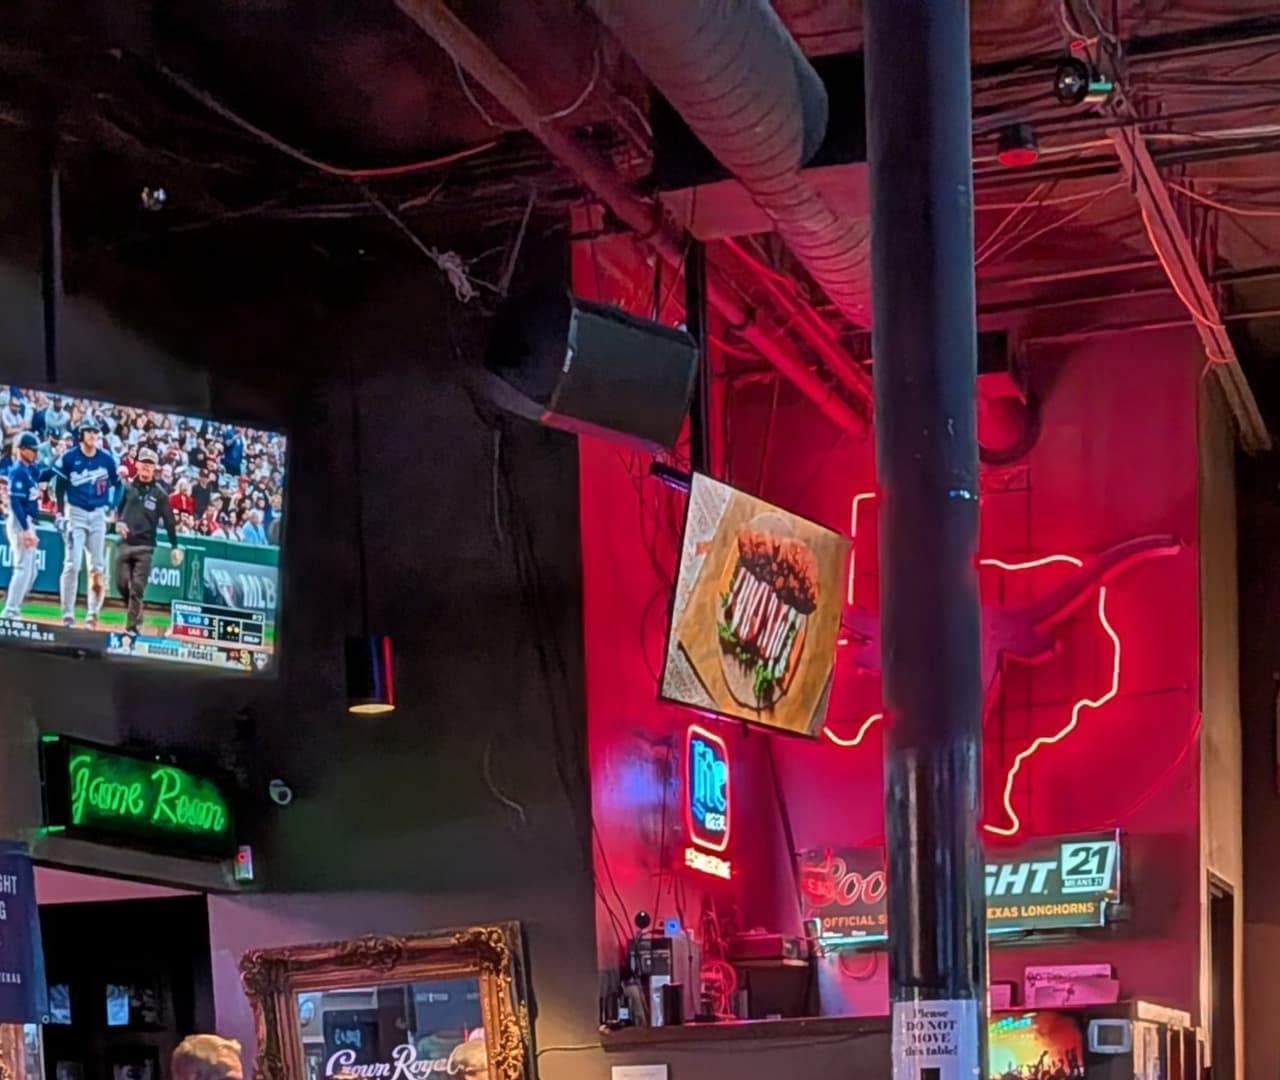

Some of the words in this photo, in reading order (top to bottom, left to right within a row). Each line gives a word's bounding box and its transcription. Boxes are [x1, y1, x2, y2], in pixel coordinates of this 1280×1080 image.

[70, 755, 144, 825] Game
[152, 768, 225, 832] Room
[1065, 846, 1111, 877] 21
[1064, 879, 1092, 888] MEANS
[987, 904, 1019, 919] EXAS
[1021, 902, 1095, 917] LONGHORNS
[823, 915, 876, 927] OFFICIAL
[906, 1020, 924, 1032] DO
[928, 1020, 956, 1031] NOT
[912, 1033, 951, 1044] MOVE
